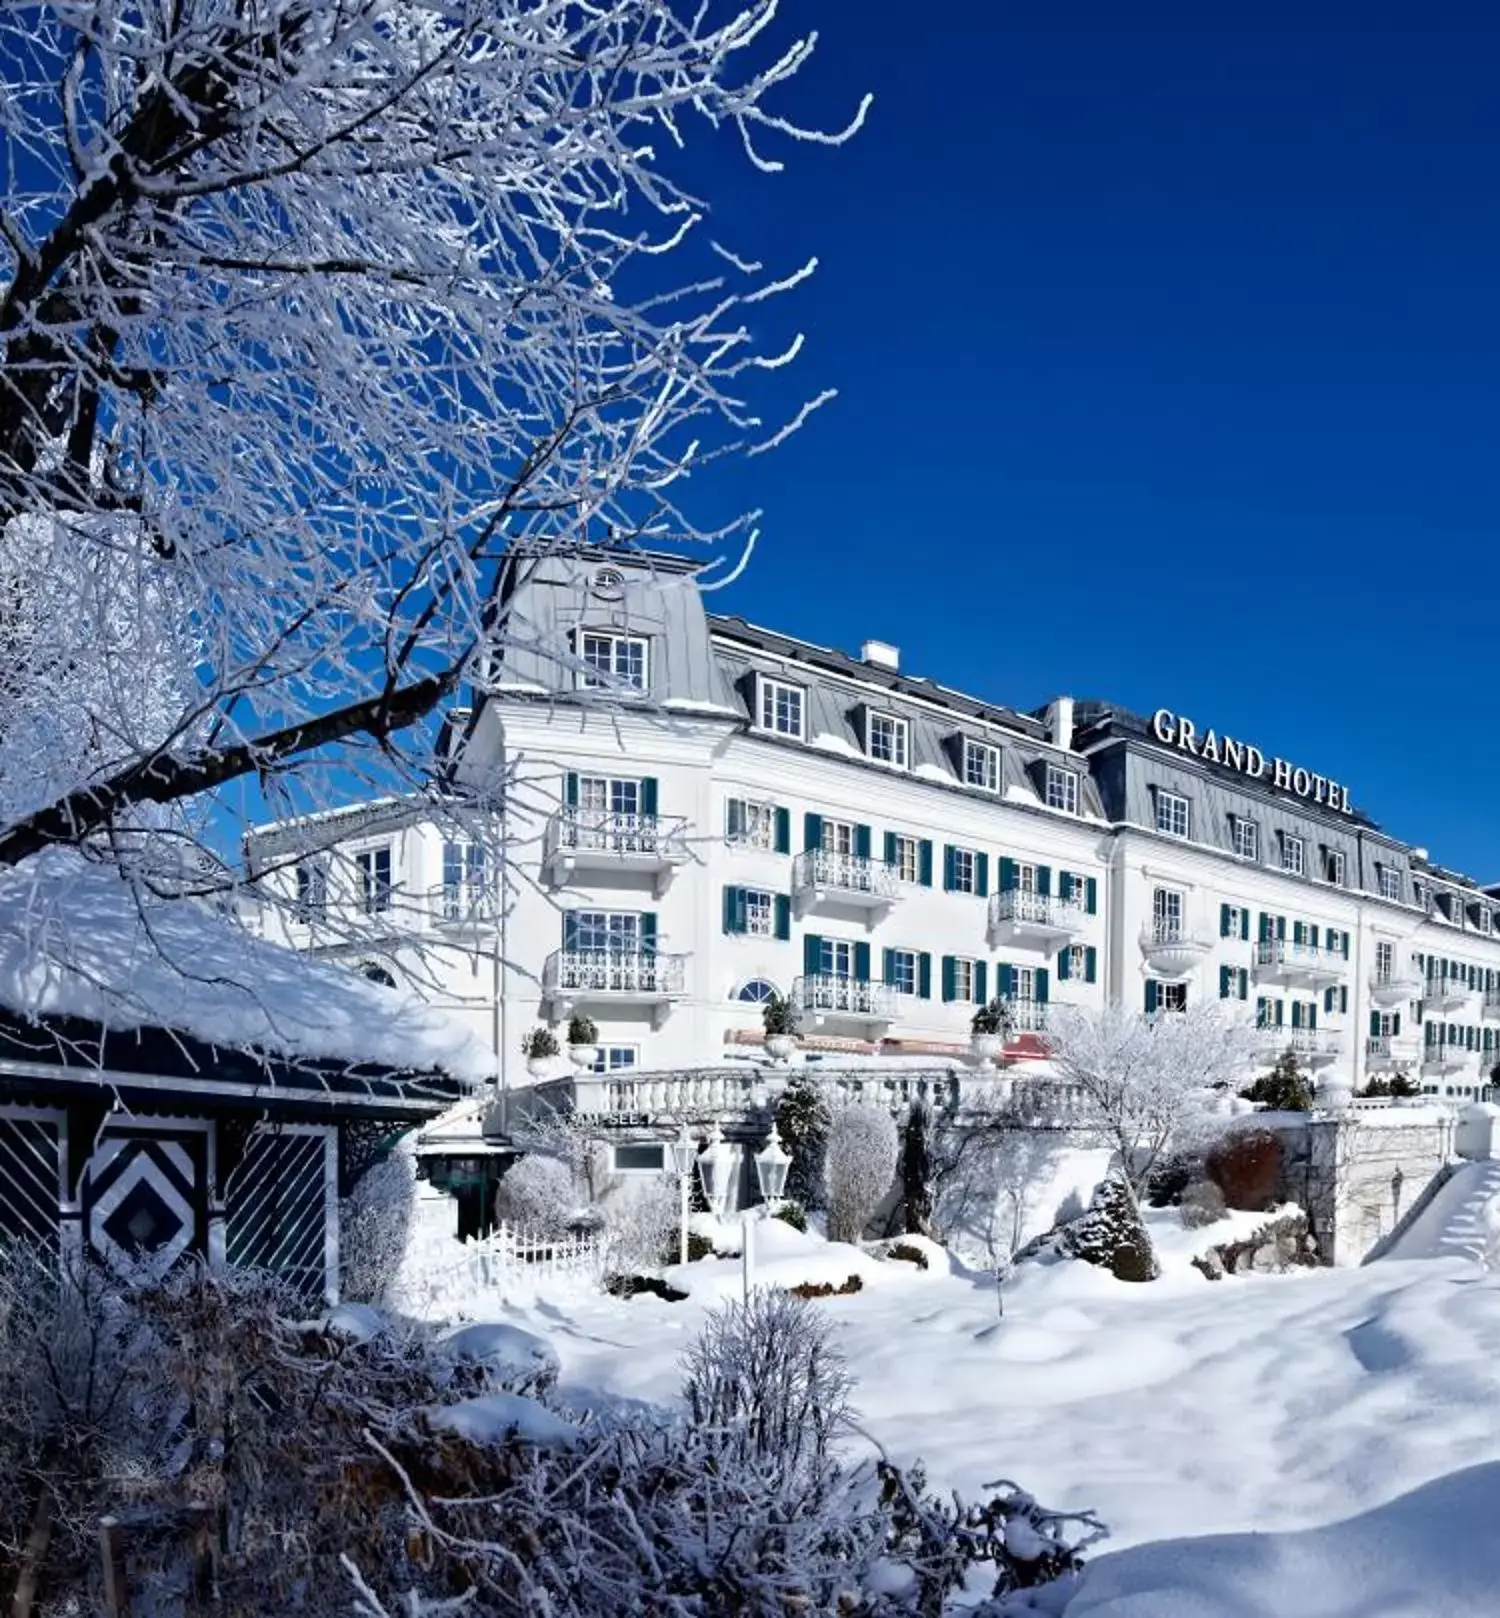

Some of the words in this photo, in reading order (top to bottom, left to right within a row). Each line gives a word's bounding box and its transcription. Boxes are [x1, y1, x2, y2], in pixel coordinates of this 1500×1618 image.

[1153, 709, 1264, 778] GRAND
[1273, 757, 1353, 815] HOTEL
[609, 1111, 638, 1125] SEE
